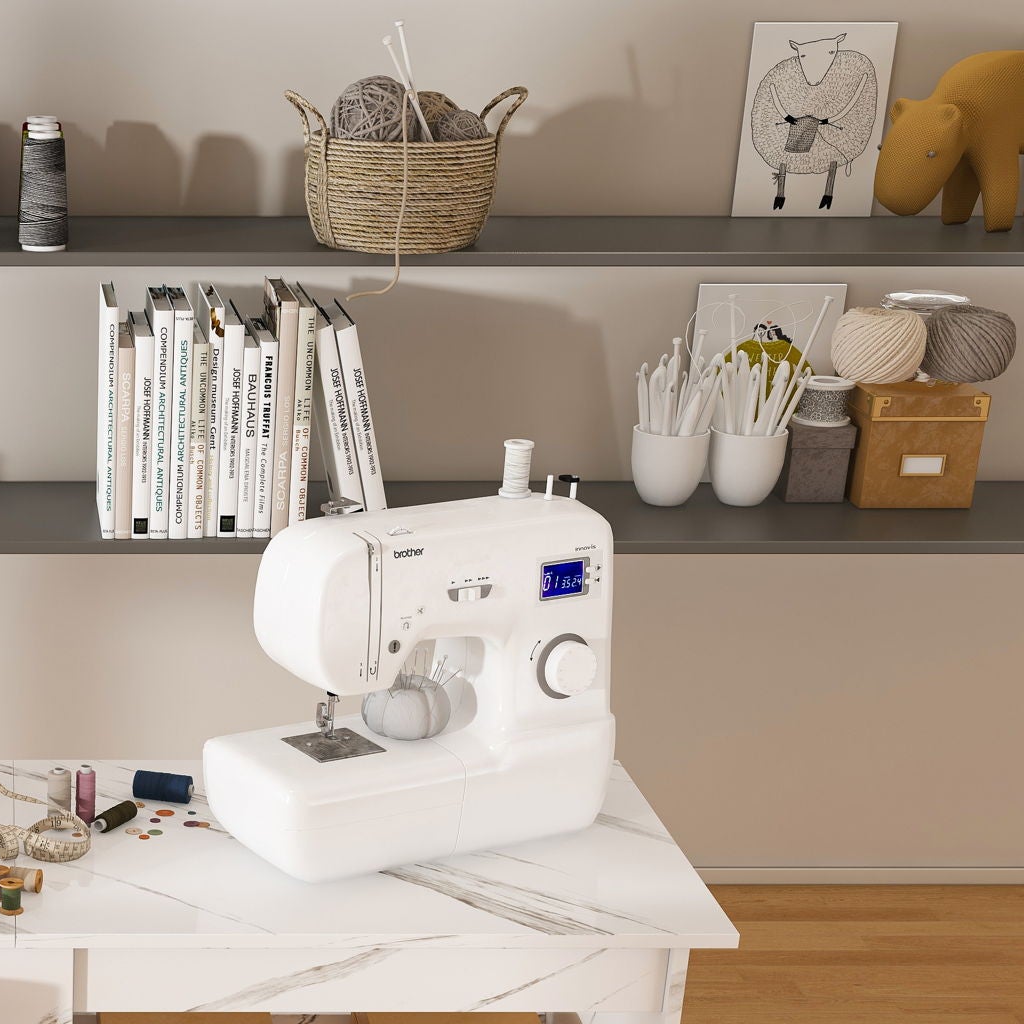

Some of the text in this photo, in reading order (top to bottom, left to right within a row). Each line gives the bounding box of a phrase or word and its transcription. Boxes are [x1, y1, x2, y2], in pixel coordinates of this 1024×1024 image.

[210, 348, 220, 379] Design
[232, 367, 241, 389] JOSEF
[264, 356, 273, 398] FRANCOIS
[330, 368, 341, 388] JOSEF
[353, 368, 364, 388] JOSEF
[121, 371, 131, 423] SCARPA
[199, 372, 207, 414] UNCOMMON
[231, 390, 240, 434] HOFFMANN
[246, 373, 257, 438] BAUHAUS
[334, 389, 349, 432] HOFFMANN
[357, 389, 371, 432] HOFFMANN
[142, 399, 151, 440] HOFFMANN
[155, 326, 167, 512] COMPENDIUM ARCHITECTURAL ANTIQUES
[175, 339, 188, 525] COMPENDIUM ARCHITECTURAL ANTIQUES
[262, 402, 270, 439] TRUFFAT
[298, 317, 315, 522] THE UNCOMMON LIFE OF COMMON OBJECT
[197, 444, 205, 454] OF
[196, 460, 204, 490] COMMON
[259, 458, 267, 493] Complete
[276, 451, 288, 512] SCARPA
[194, 494, 202, 530] OBJECTS
[393, 547, 424, 559] brother
[542, 575, 559, 592] 01
